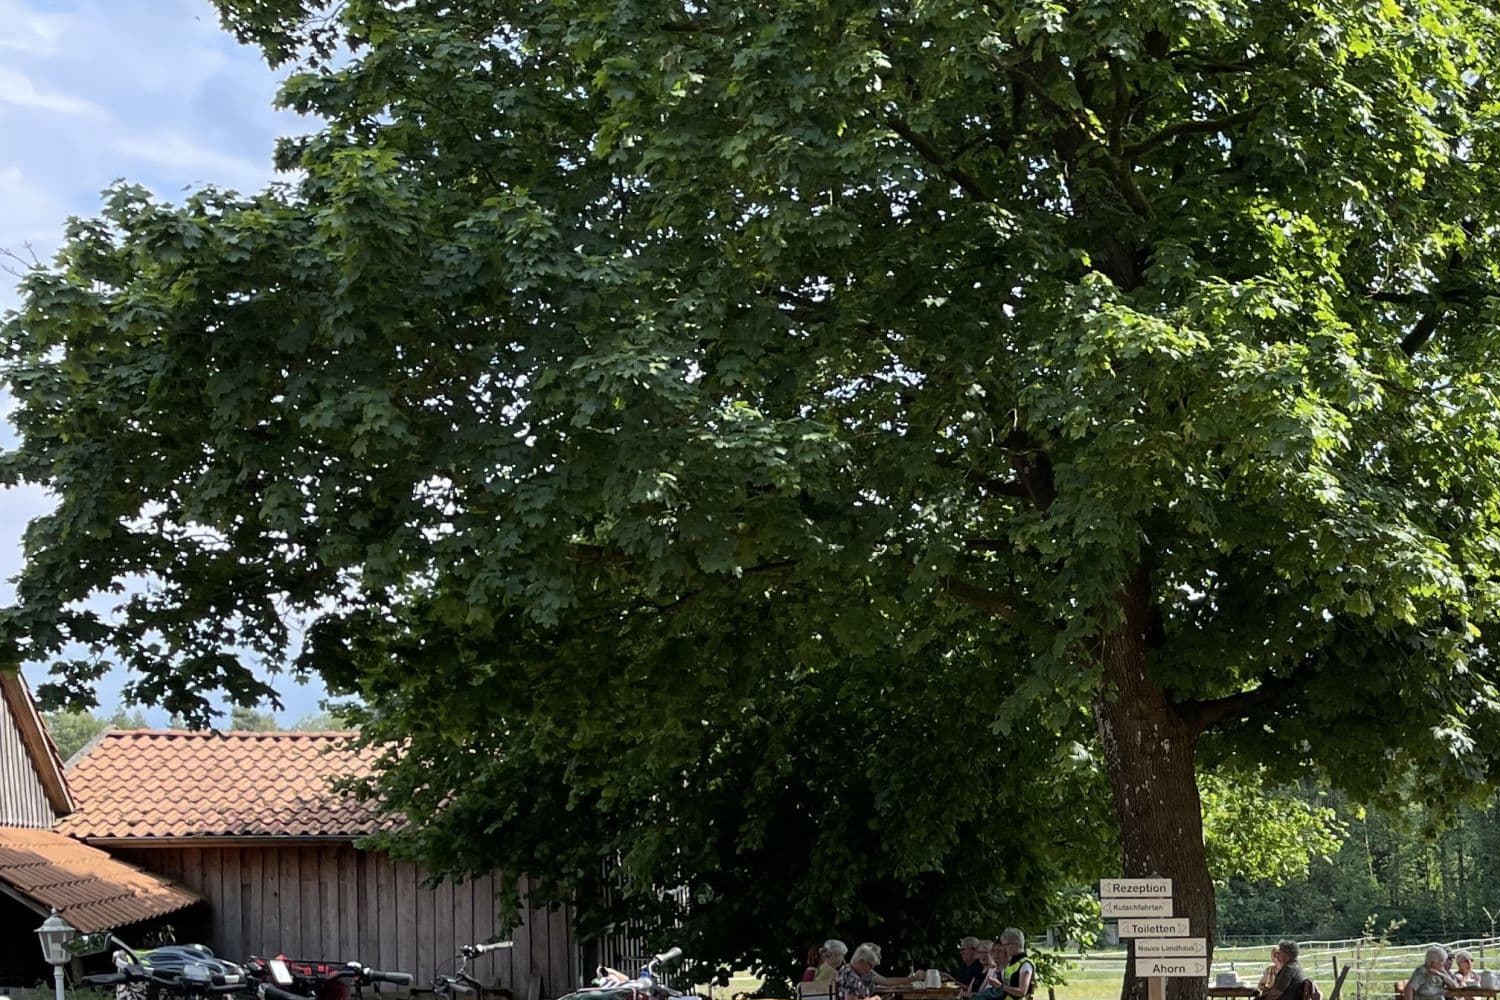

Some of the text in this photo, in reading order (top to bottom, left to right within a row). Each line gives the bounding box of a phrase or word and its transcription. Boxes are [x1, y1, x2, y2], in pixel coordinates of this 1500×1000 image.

[1112, 883, 1166, 894] Rezeption
[1132, 924, 1176, 934] Toiletten
[1161, 944, 1195, 952] Landhaus
[1152, 964, 1186, 974] Ahorn
